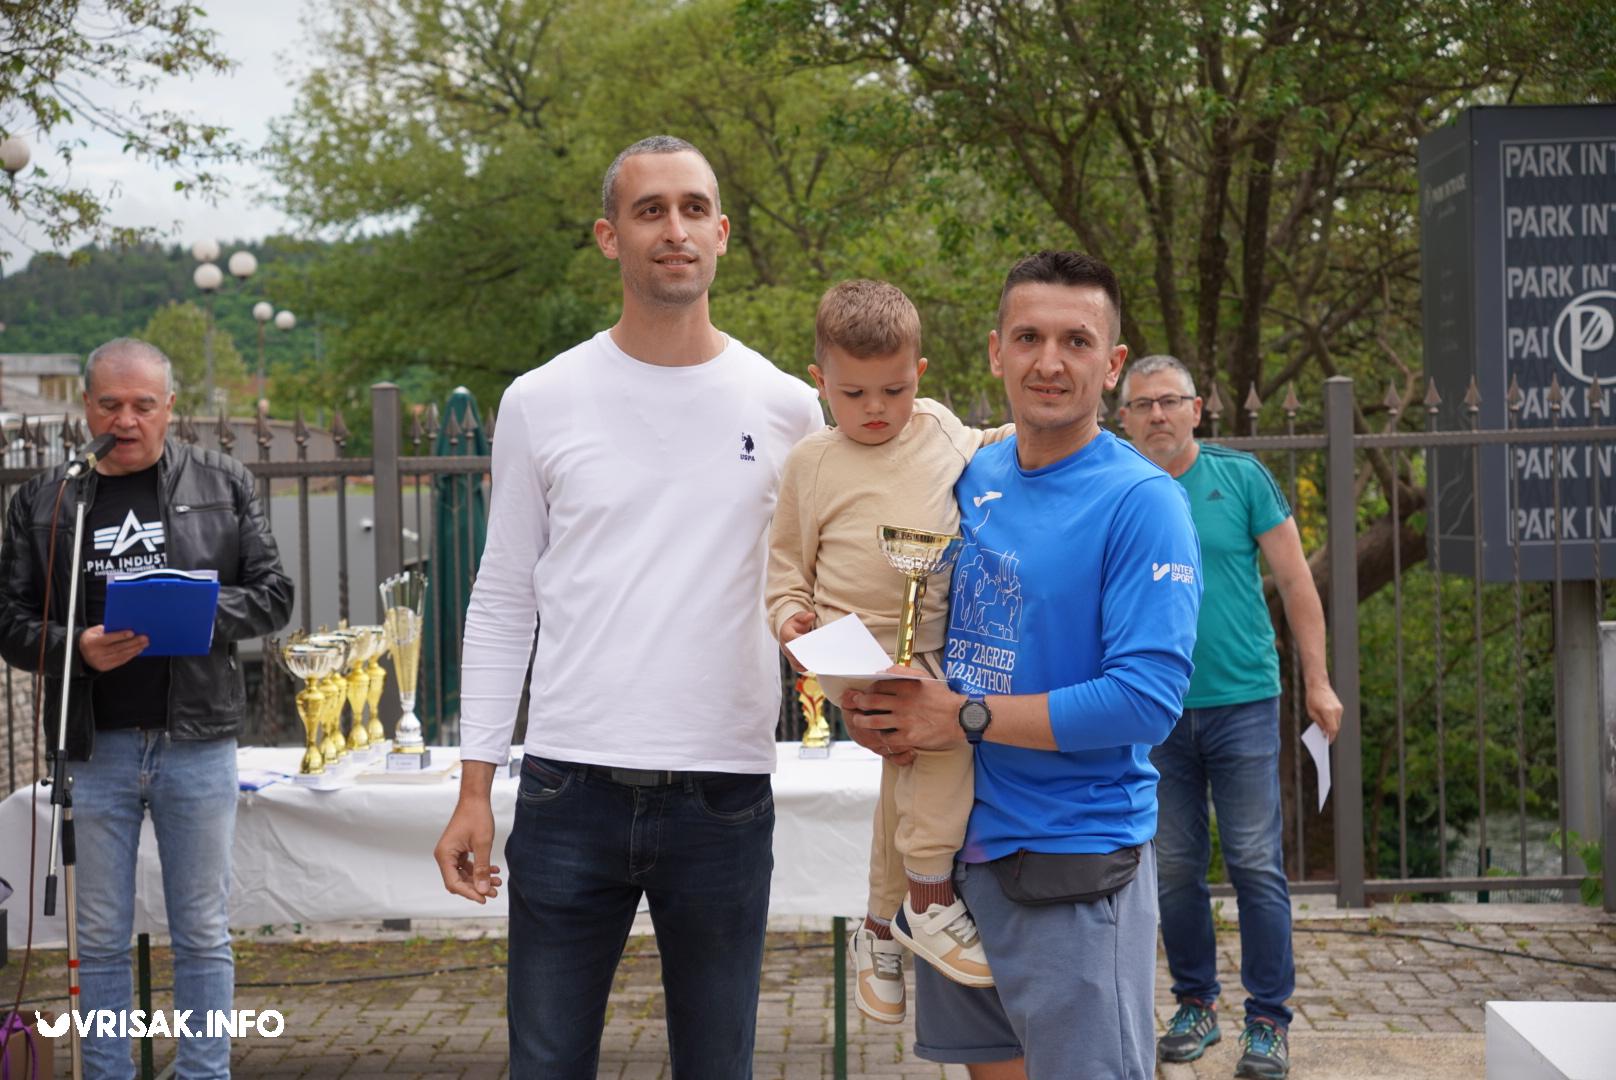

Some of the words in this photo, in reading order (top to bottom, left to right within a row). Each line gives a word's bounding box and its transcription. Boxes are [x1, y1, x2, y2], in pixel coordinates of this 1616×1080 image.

[1505, 144, 1574, 178] PARK
[1506, 204, 1575, 239] PARK
[1507, 264, 1575, 299] PARK
[1582, 263, 1616, 290] IN
[1584, 386, 1616, 418] IN
[1510, 446, 1578, 480] PARK
[1585, 445, 1616, 478] IN
[1511, 506, 1579, 540] PARK
[1586, 505, 1616, 538] IN
[83, 559, 114, 573] PHA
[1171, 562, 1194, 575] INTER
[1171, 572, 1193, 584] SPORT
[972, 642, 1016, 671] ZAGREB
[946, 661, 1012, 694] MARATHON
